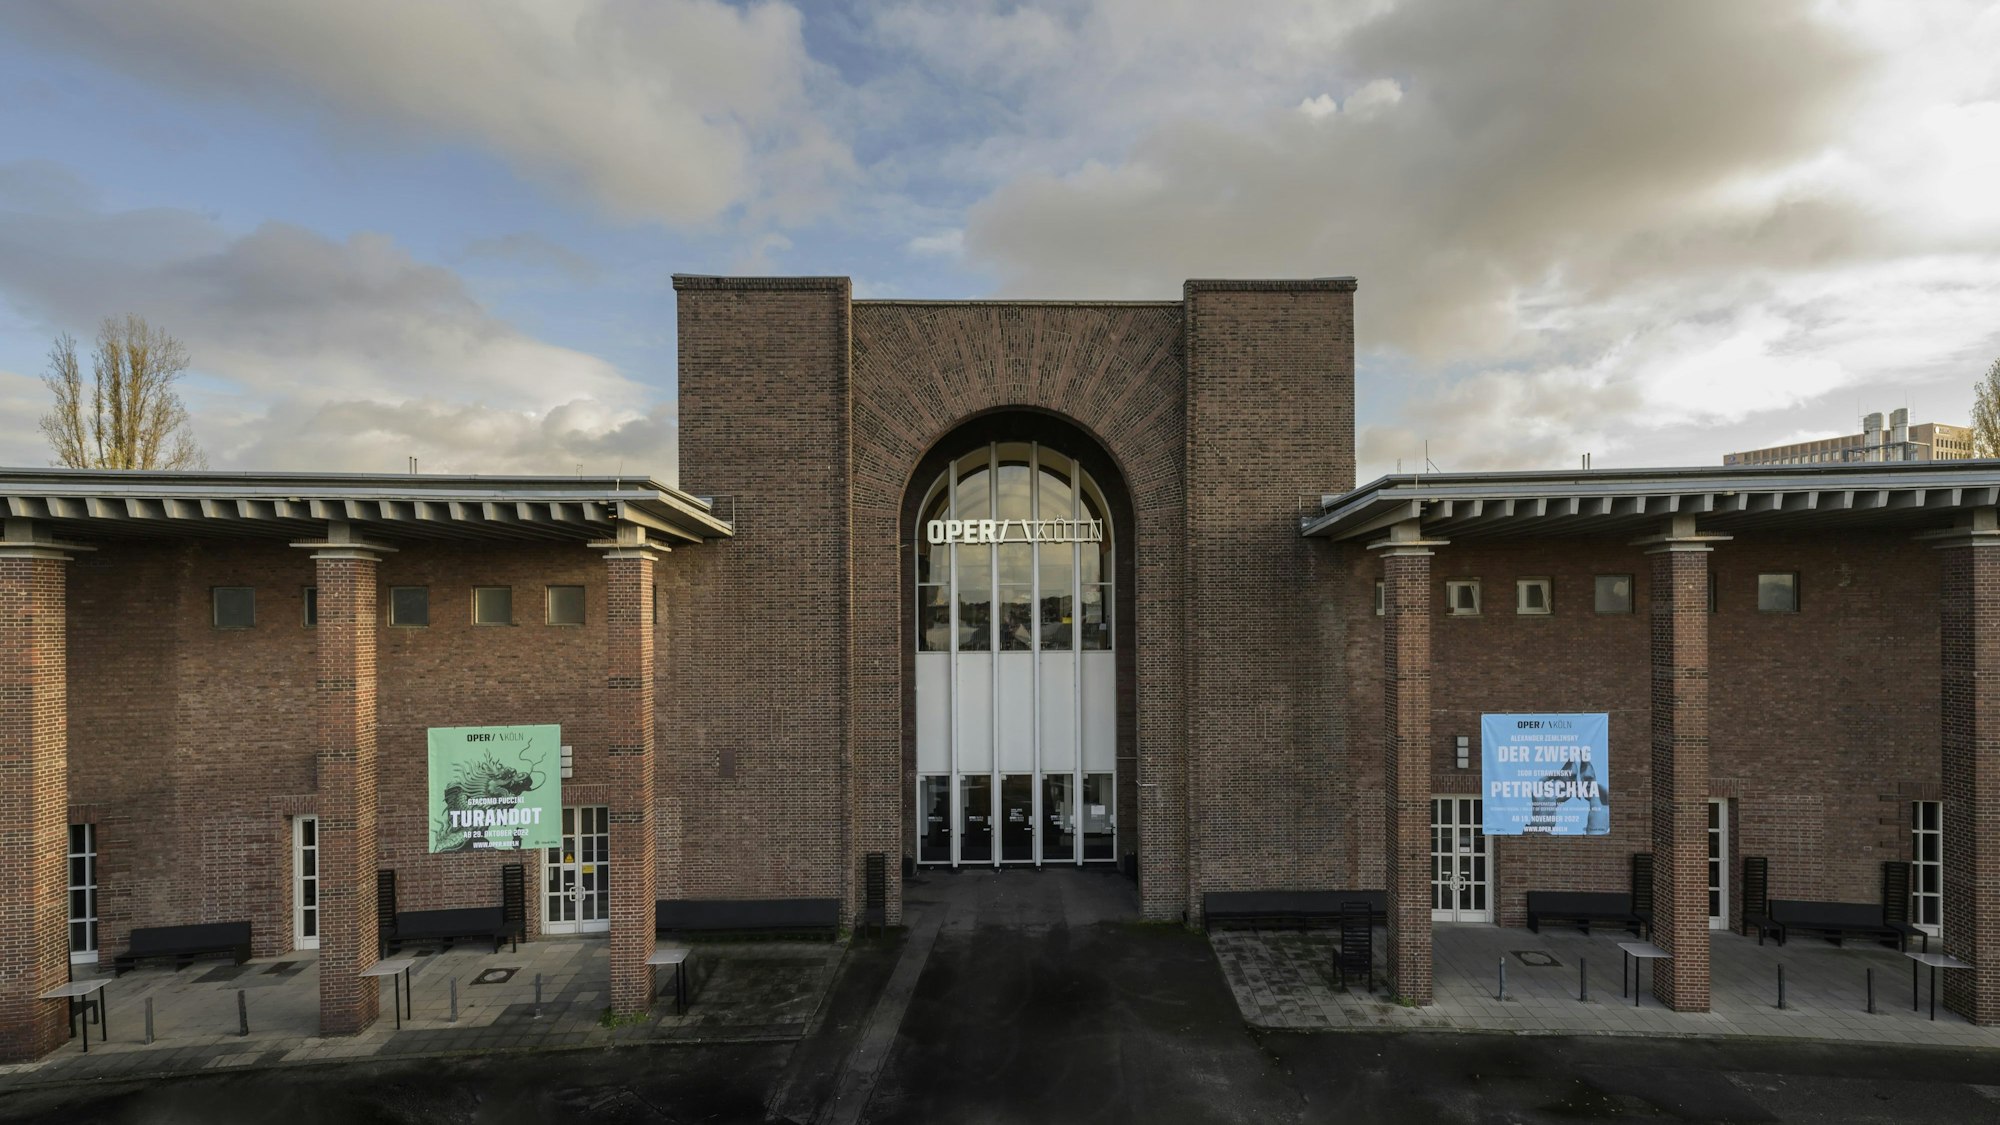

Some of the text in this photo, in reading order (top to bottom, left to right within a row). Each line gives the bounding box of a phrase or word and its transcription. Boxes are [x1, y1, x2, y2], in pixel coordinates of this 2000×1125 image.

[1498, 746, 1592, 762] DER ZWERG
[1491, 780, 1600, 798] PETRUSCHKA
[468, 796, 525, 806] GIACOMO PUCCINI
[450, 808, 542, 828] TURANDOT
